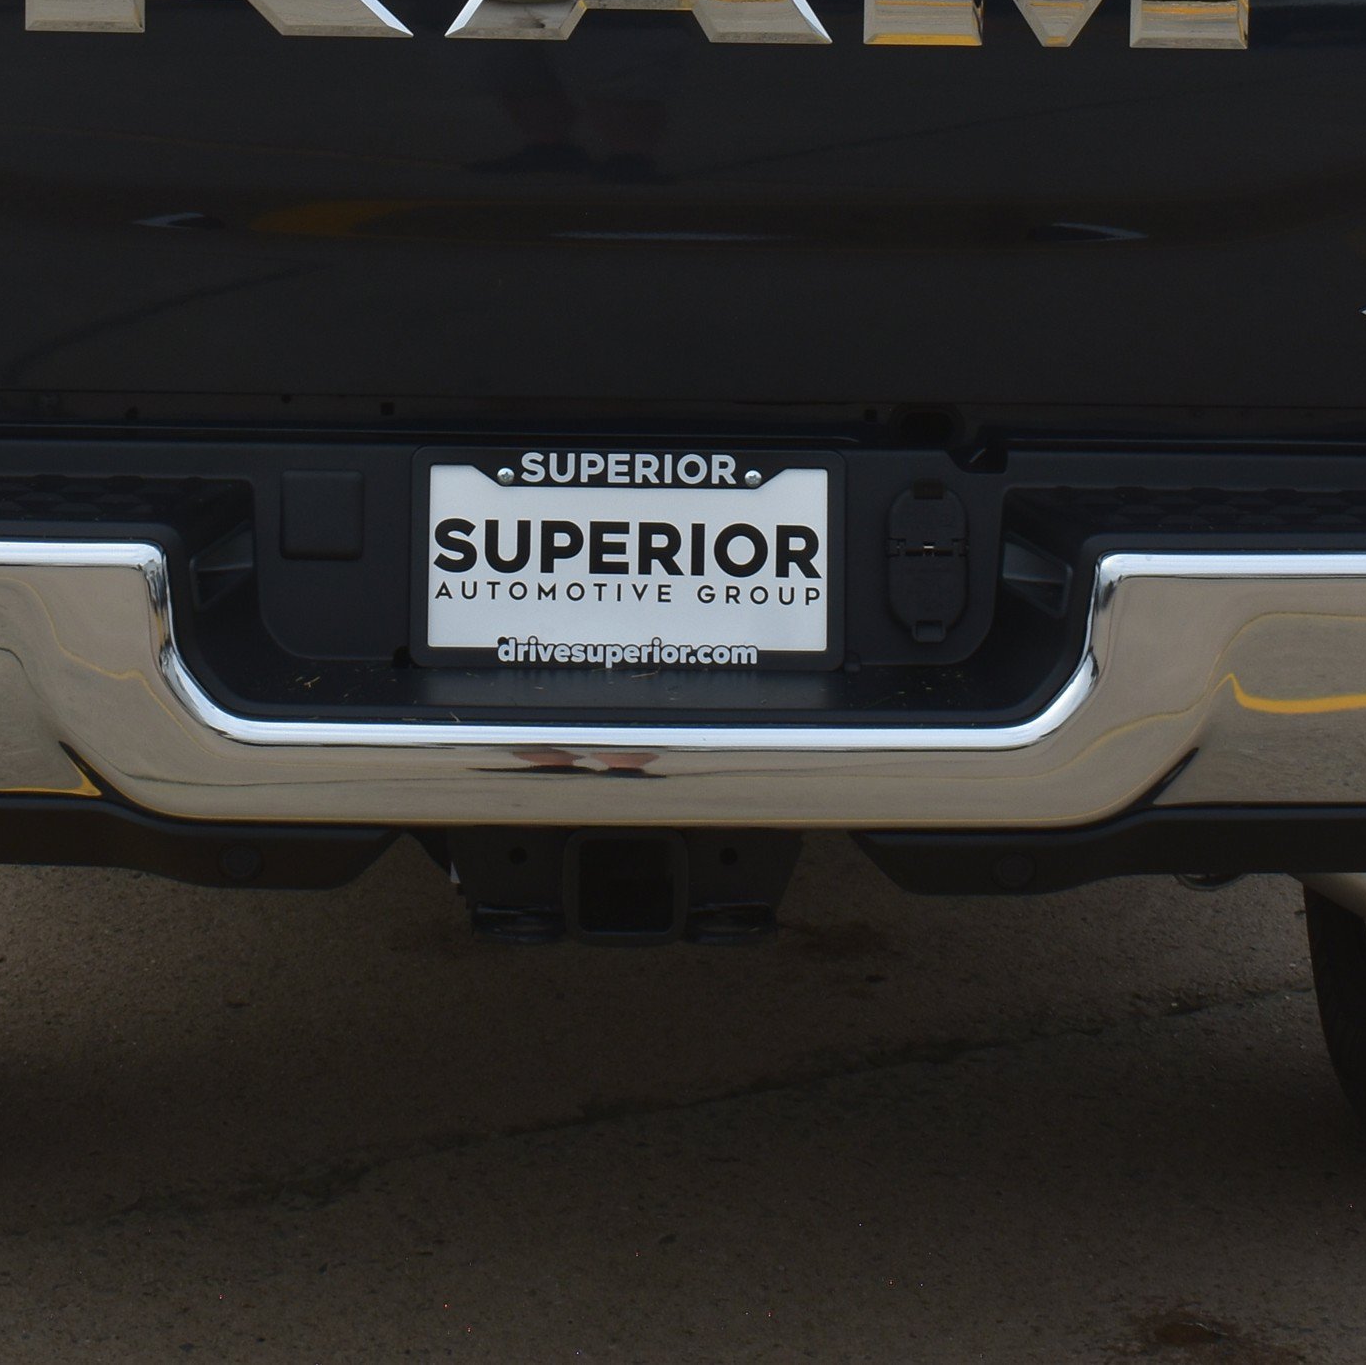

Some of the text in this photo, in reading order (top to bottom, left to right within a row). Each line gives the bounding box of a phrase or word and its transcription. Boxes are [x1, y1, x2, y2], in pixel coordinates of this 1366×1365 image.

[520, 451, 738, 486] SUPERIOR
[433, 517, 823, 580] SUPERIOR
[434, 580, 822, 607] AUTOMOTIVE GROUP
[497, 636, 759, 669] drivesuperior.com
